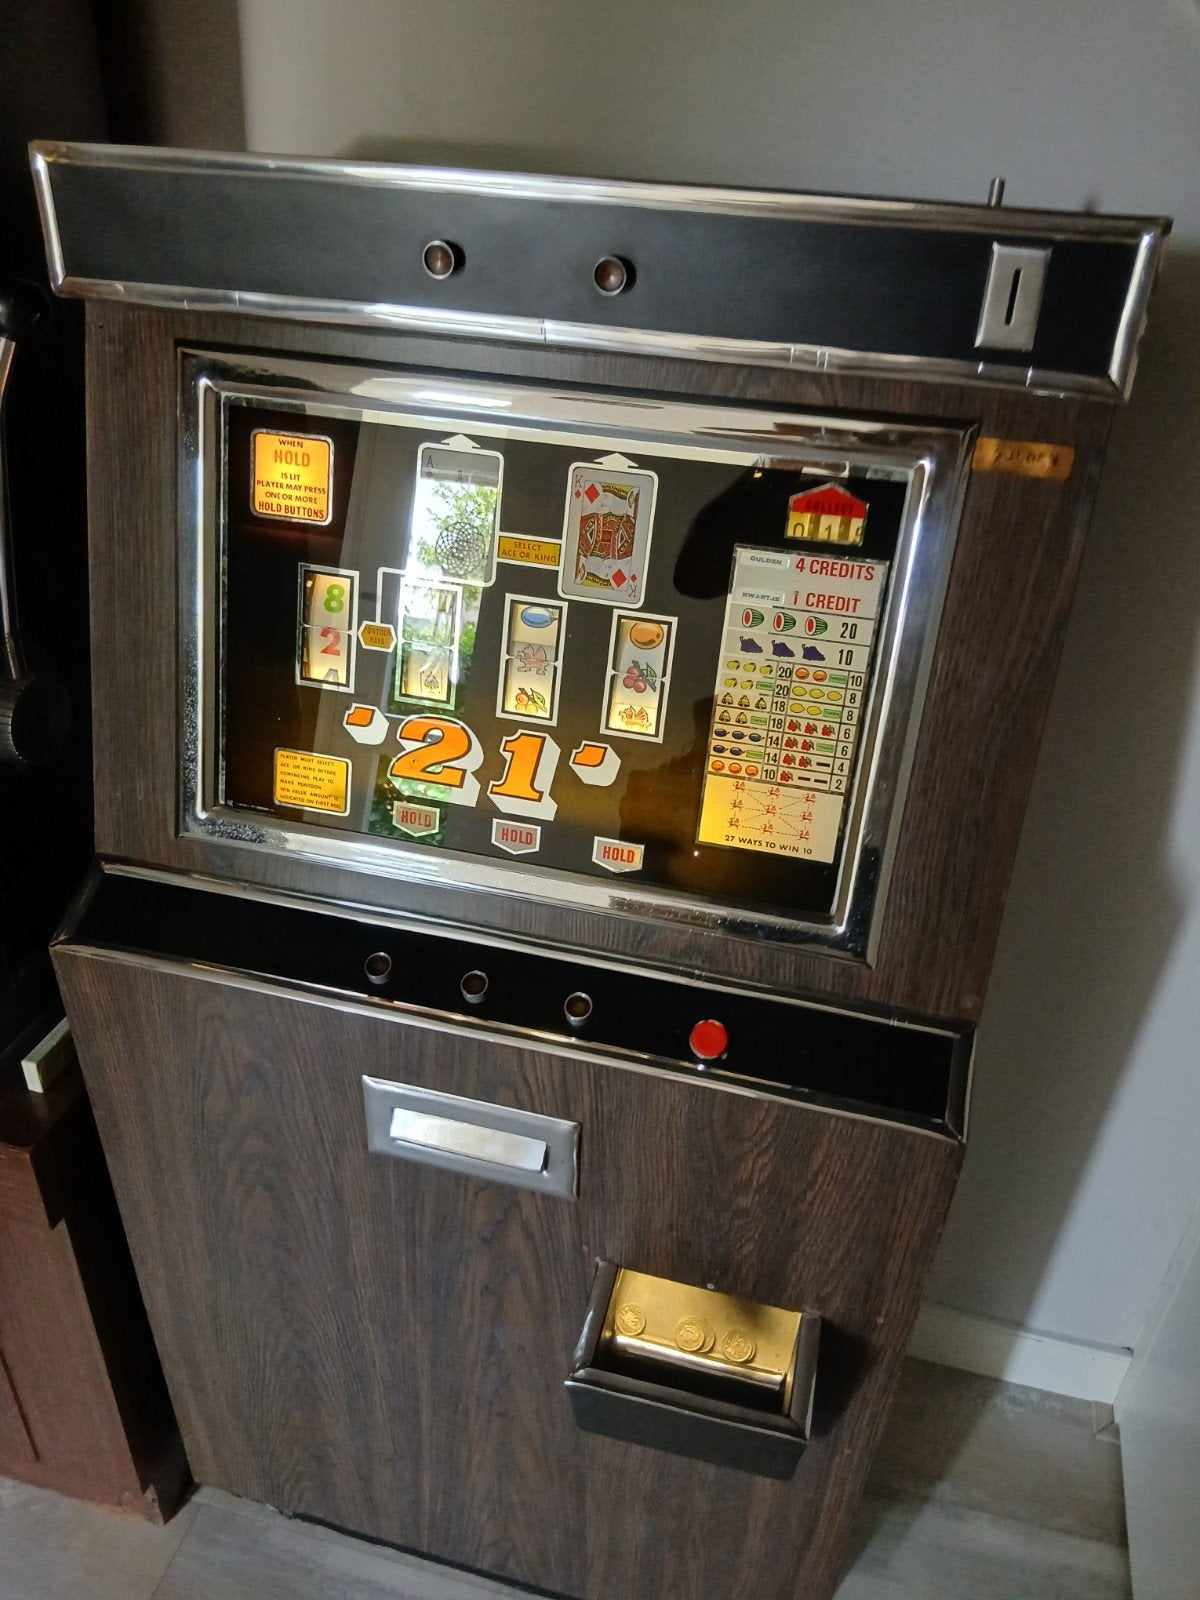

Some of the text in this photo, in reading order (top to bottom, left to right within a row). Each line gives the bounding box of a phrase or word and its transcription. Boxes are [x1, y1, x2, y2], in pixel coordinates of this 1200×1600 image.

[278, 439, 303, 448] WHEN
[274, 450, 310, 467] HOLD
[256, 480, 284, 489] PLAYER
[304, 486, 326, 494] PRESS
[575, 474, 584, 488] K
[295, 495, 318, 504] MORE
[258, 501, 324, 519] HOLD BUTTONS
[514, 541, 542, 550] SELECT
[501, 549, 557, 563] ACE OR KING
[795, 559, 875, 581] 4 CREDITS
[324, 584, 345, 613] 8
[742, 592, 780, 602] KWARTJE
[805, 593, 861, 613] CREDIT
[840, 623, 857, 639] 20
[320, 627, 341, 656] 2
[838, 649, 853, 666] 10
[778, 666, 792, 678] 20
[850, 676, 863, 687] 10
[776, 684, 789, 696] 20
[850, 693, 856, 704] 8
[774, 701, 786, 712] 18
[846, 710, 853, 721] 8
[771, 718, 783, 730] 18
[844, 728, 850, 739] 6
[768, 736, 780, 747] 14
[841, 745, 847, 756] 6
[766, 752, 778, 764] 14
[837, 762, 844, 773] 4
[764, 768, 776, 780] 10
[835, 779, 842, 790] 2
[400, 809, 431, 828] HOLD
[501, 828, 533, 846] HOLD
[738, 836, 763, 847] WAYS
[779, 844, 799, 853] WIN
[602, 846, 635, 864] HOLD
